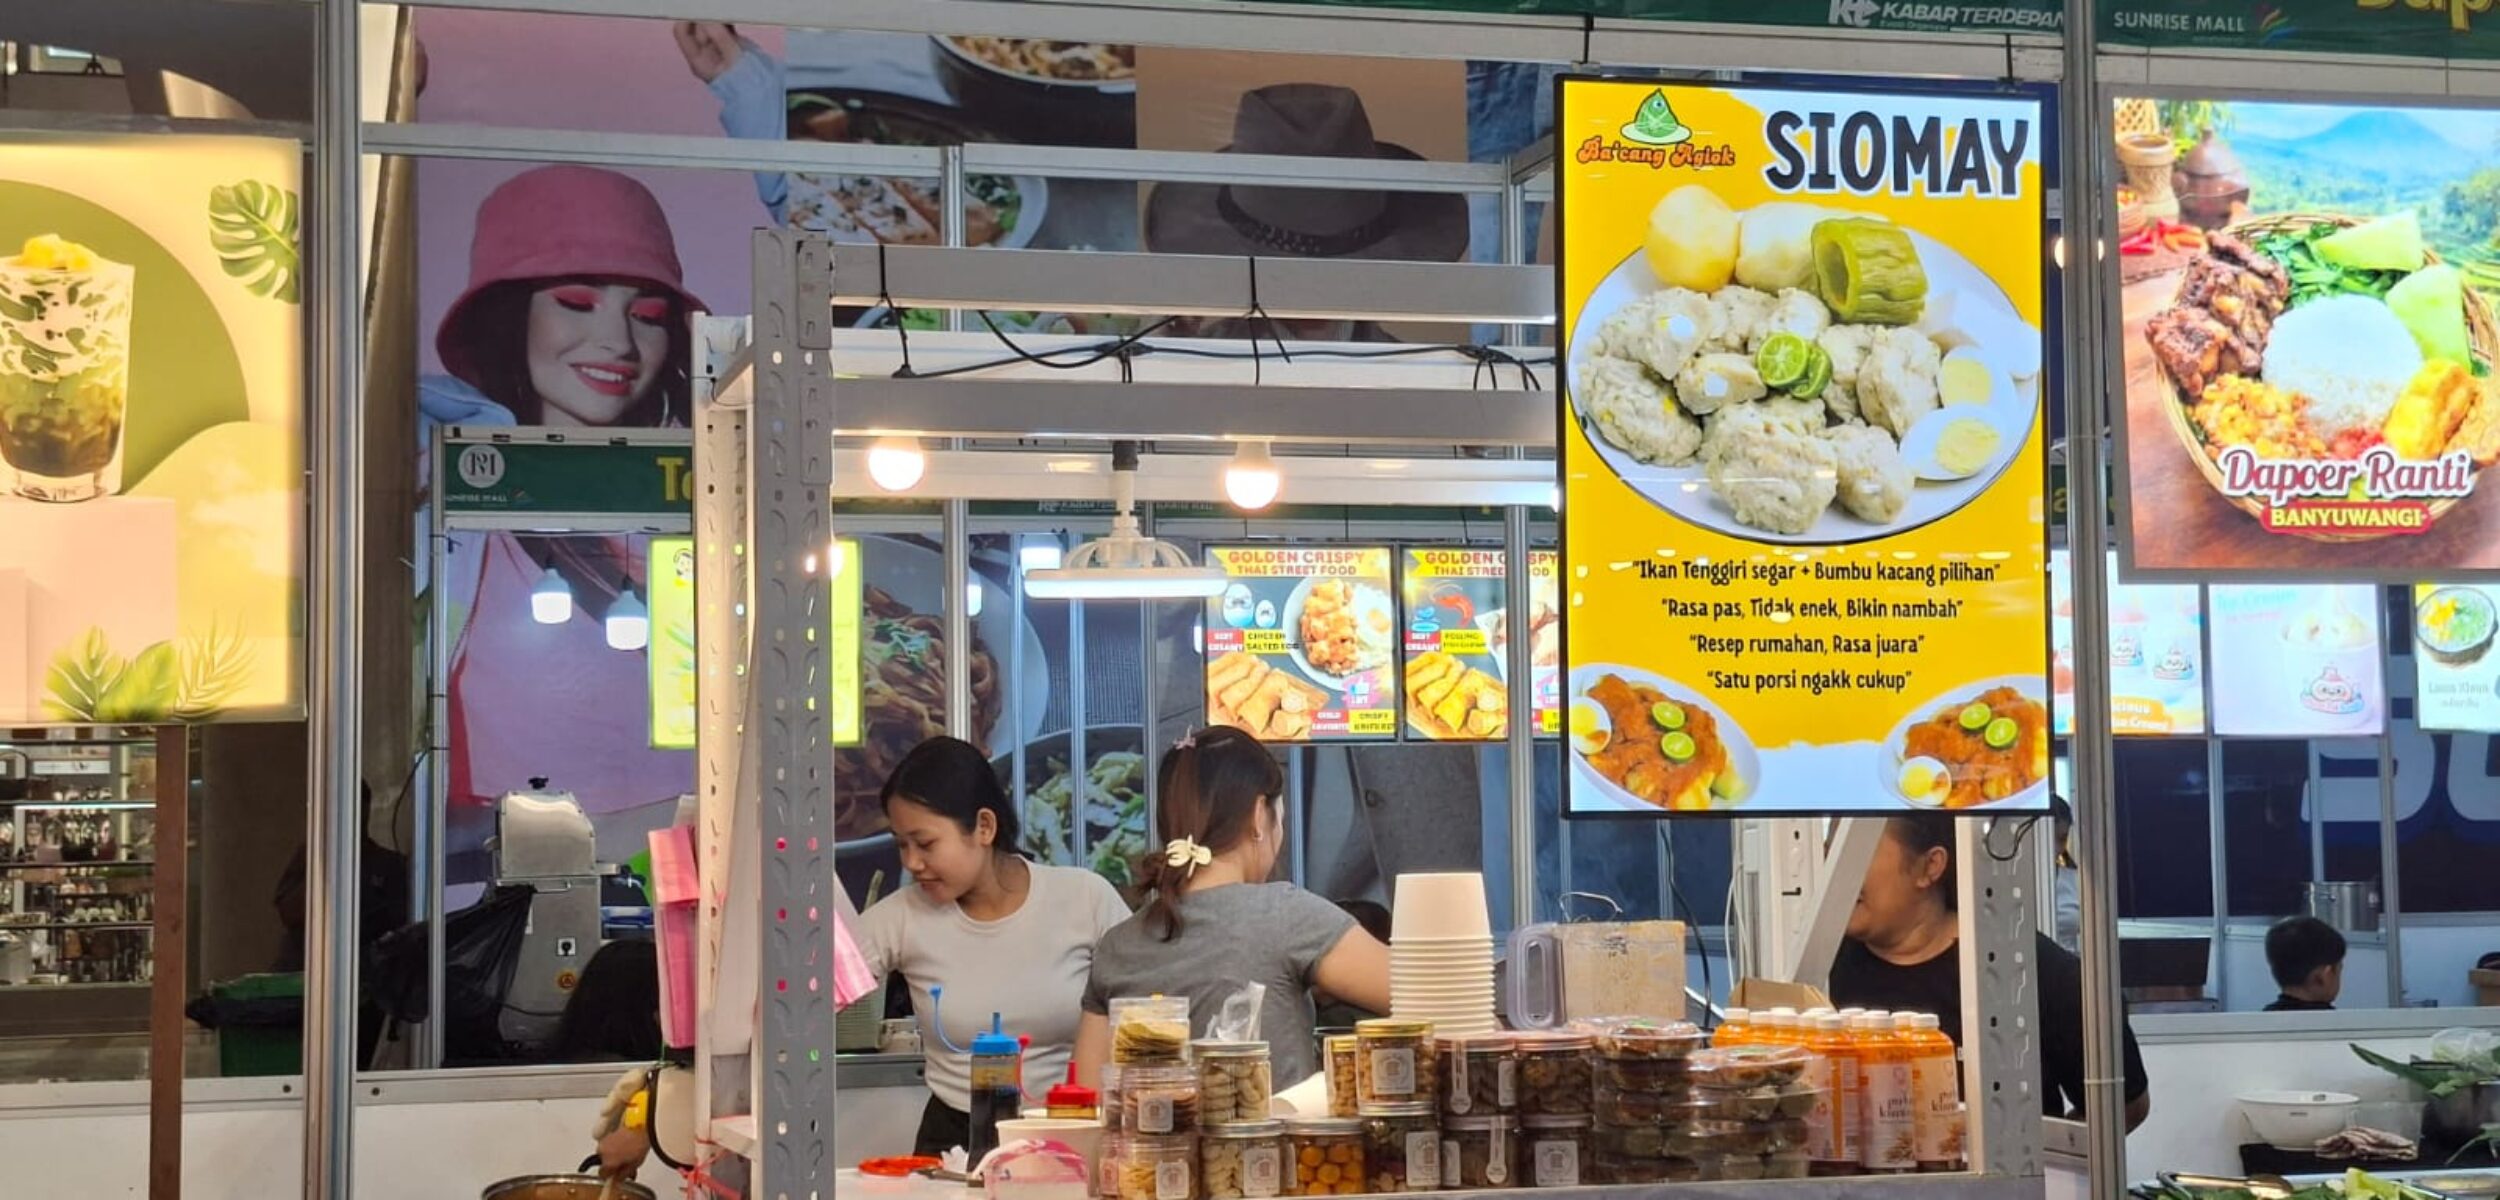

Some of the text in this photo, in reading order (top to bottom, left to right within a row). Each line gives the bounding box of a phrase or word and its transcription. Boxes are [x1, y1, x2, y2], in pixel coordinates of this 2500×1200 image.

[1881, 2, 1958, 22] KABAR
[2113, 11, 2245, 33] SUNRISE MALL
[1764, 109, 2030, 197] SIOMAY
[2223, 448, 2468, 502] Dapoer Ranti
[2270, 508, 2423, 527] BANYUWANGI
[1229, 551, 1365, 564] GOLDEN CRISPY
[1425, 552, 1493, 565] GOLDEN
[1237, 565, 1357, 576] THAI STREET FOOD
[1434, 566, 1463, 576] THAI
[1466, 566, 1506, 577] STREE
[1632, 560, 1677, 579] "Ikan
[1683, 560, 1747, 586] Tenggiri
[1752, 565, 1796, 586] segar
[1815, 561, 1871, 580] Bumbu
[1876, 561, 1936, 587] kacang
[1939, 562, 2001, 586] pilihan"
[1662, 598, 1963, 622] "Rasa pas, Tidak enek, Bikin nambah"
[1690, 634, 1925, 658] "Resep rumahan, Rasa juara"
[1707, 670, 1912, 695] "Satu porsi ngakk cukup"
